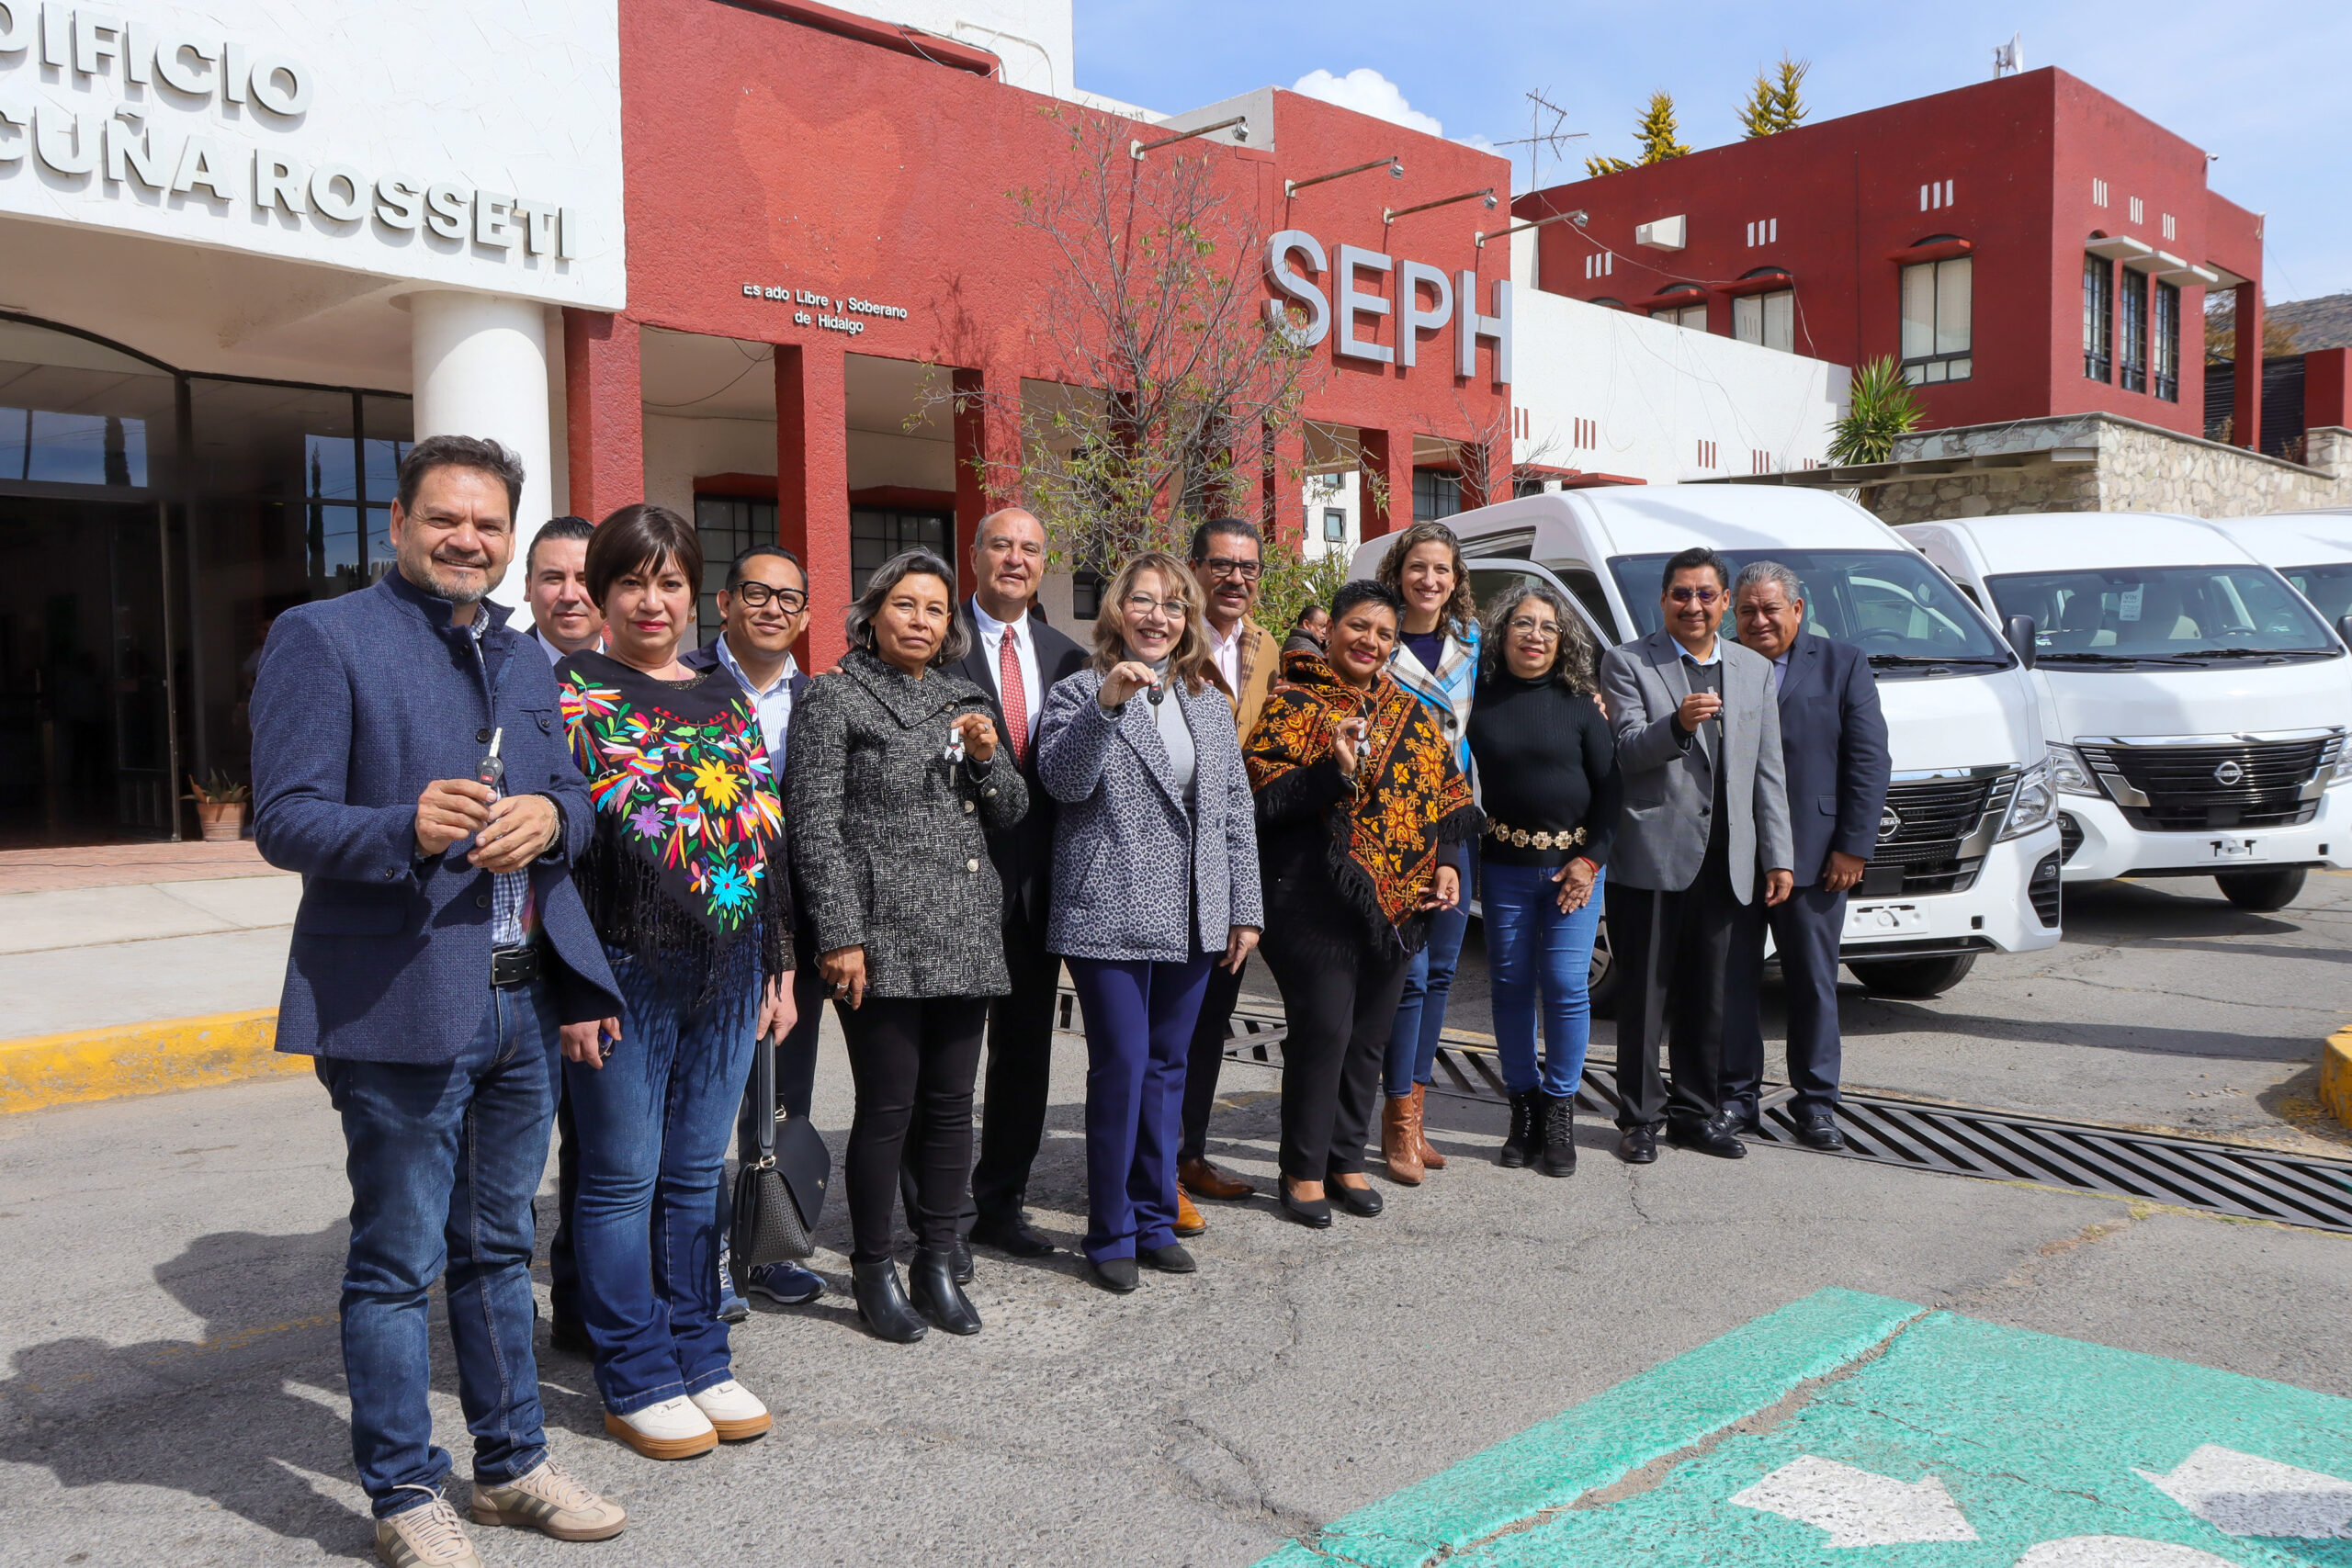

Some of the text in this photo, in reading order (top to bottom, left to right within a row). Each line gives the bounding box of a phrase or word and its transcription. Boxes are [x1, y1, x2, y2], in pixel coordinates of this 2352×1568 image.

[254, 147, 576, 261] ROSSETI
[794, 310, 865, 335] de Hidalgo
[795, 288, 829, 307] Libre
[834, 299, 843, 313] y
[847, 297, 908, 319] Soberano
[1261, 229, 1513, 385] SEPH
